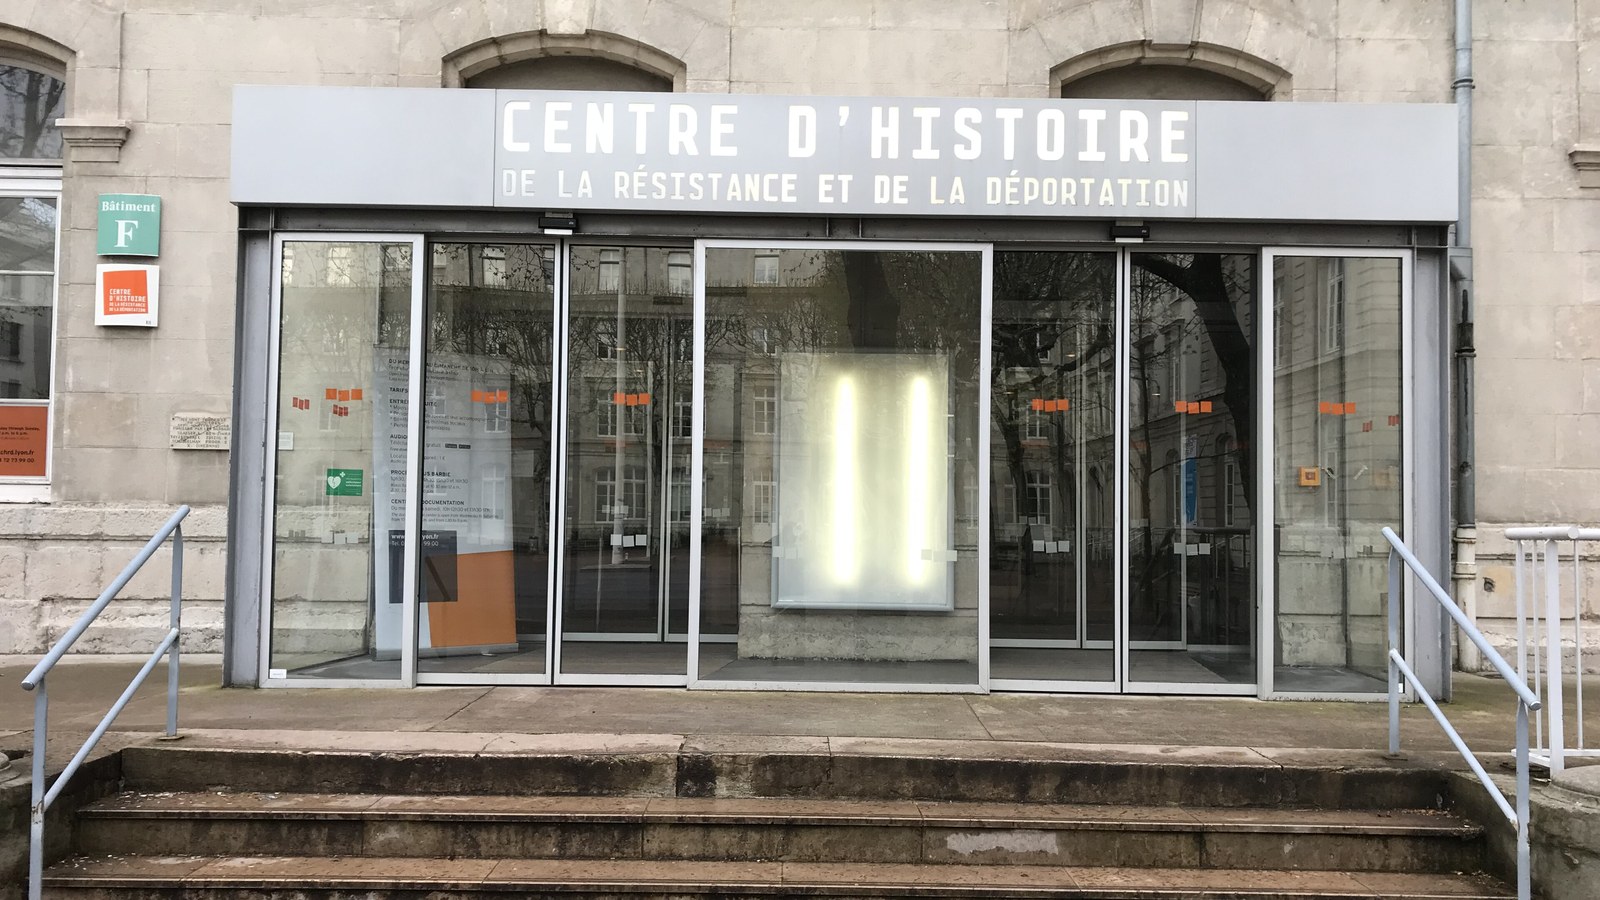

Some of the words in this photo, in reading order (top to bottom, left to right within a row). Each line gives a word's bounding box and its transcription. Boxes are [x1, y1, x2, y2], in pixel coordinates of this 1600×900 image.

[503, 101, 738, 157] CENTRE
[788, 105, 1189, 163] D'HISTOIRE
[502, 169, 536, 197] DE
[558, 170, 593, 199] LA
[614, 164, 798, 203] RÉSISTANCE
[818, 174, 854, 204] ET
[873, 174, 909, 205] DE
[930, 175, 965, 206] LA
[986, 170, 1189, 208] DÉPORTATION
[102, 200, 156, 212] Bâtiment
[114, 219, 138, 248] F
